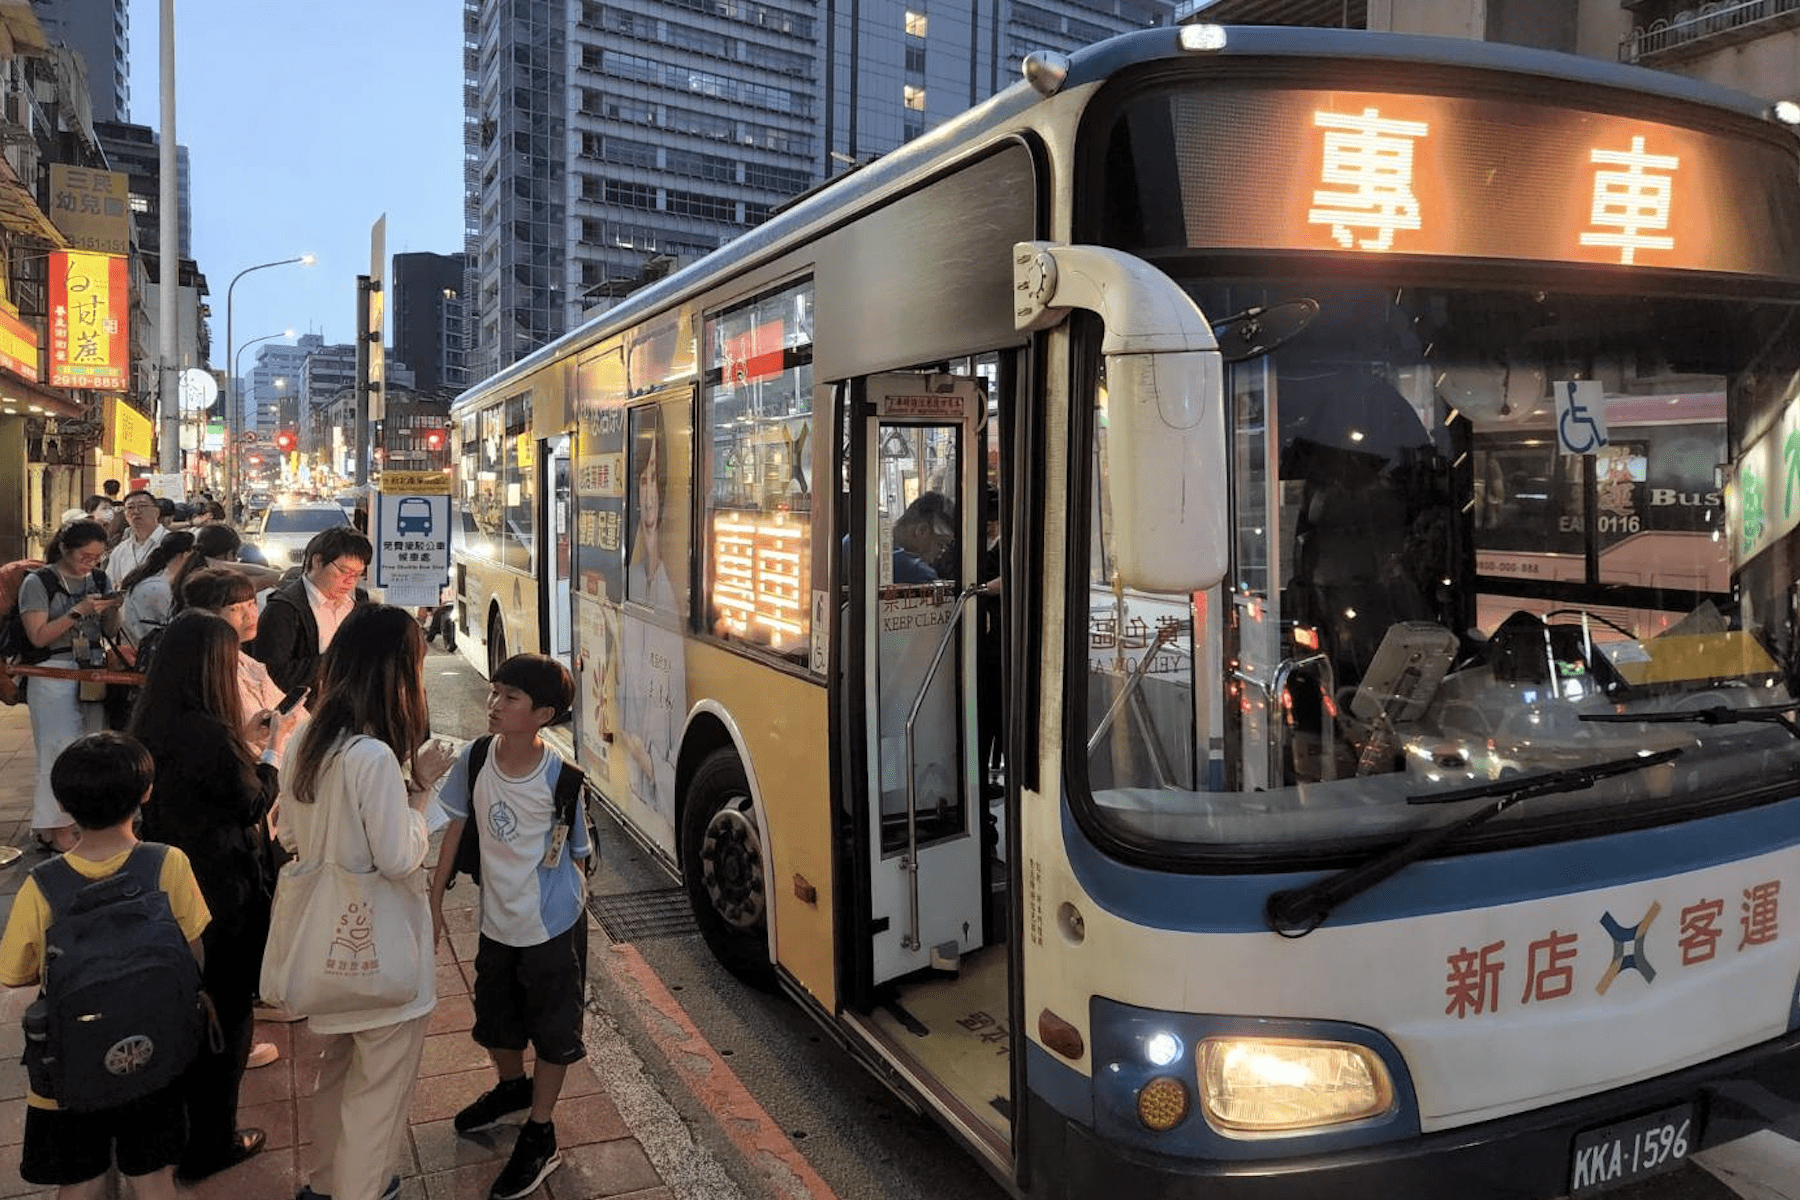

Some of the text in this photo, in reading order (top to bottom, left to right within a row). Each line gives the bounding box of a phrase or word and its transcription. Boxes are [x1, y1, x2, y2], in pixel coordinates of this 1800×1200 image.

[1651, 489, 1721, 507] Bus
[884, 615, 913, 632] KEEP
[1445, 880, 1781, 1020] 新店 客運
